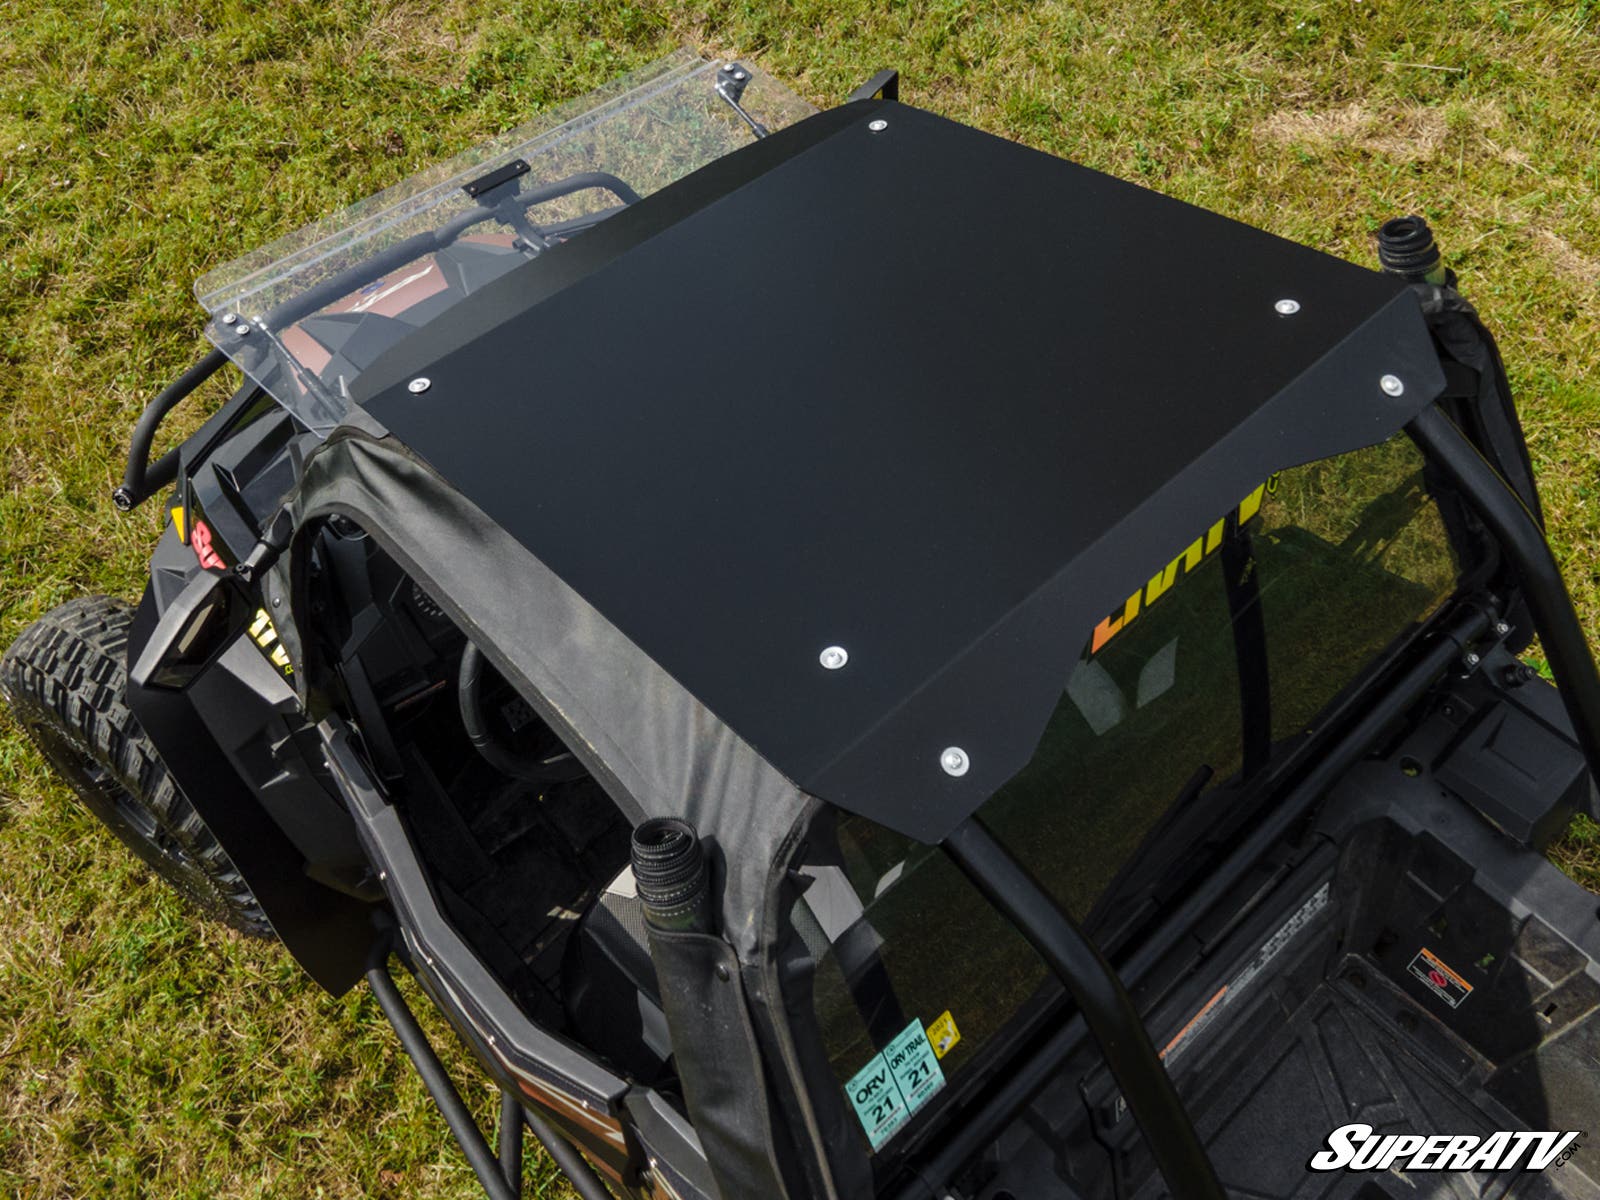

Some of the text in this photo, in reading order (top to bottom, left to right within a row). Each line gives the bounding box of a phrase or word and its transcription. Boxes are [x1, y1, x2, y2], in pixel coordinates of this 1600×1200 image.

[890, 1051, 907, 1070] ORV
[905, 1034, 926, 1055] TRAIL
[856, 1068, 886, 1104] ORV
[908, 1060, 930, 1090] 21
[871, 1096, 894, 1124] 21
